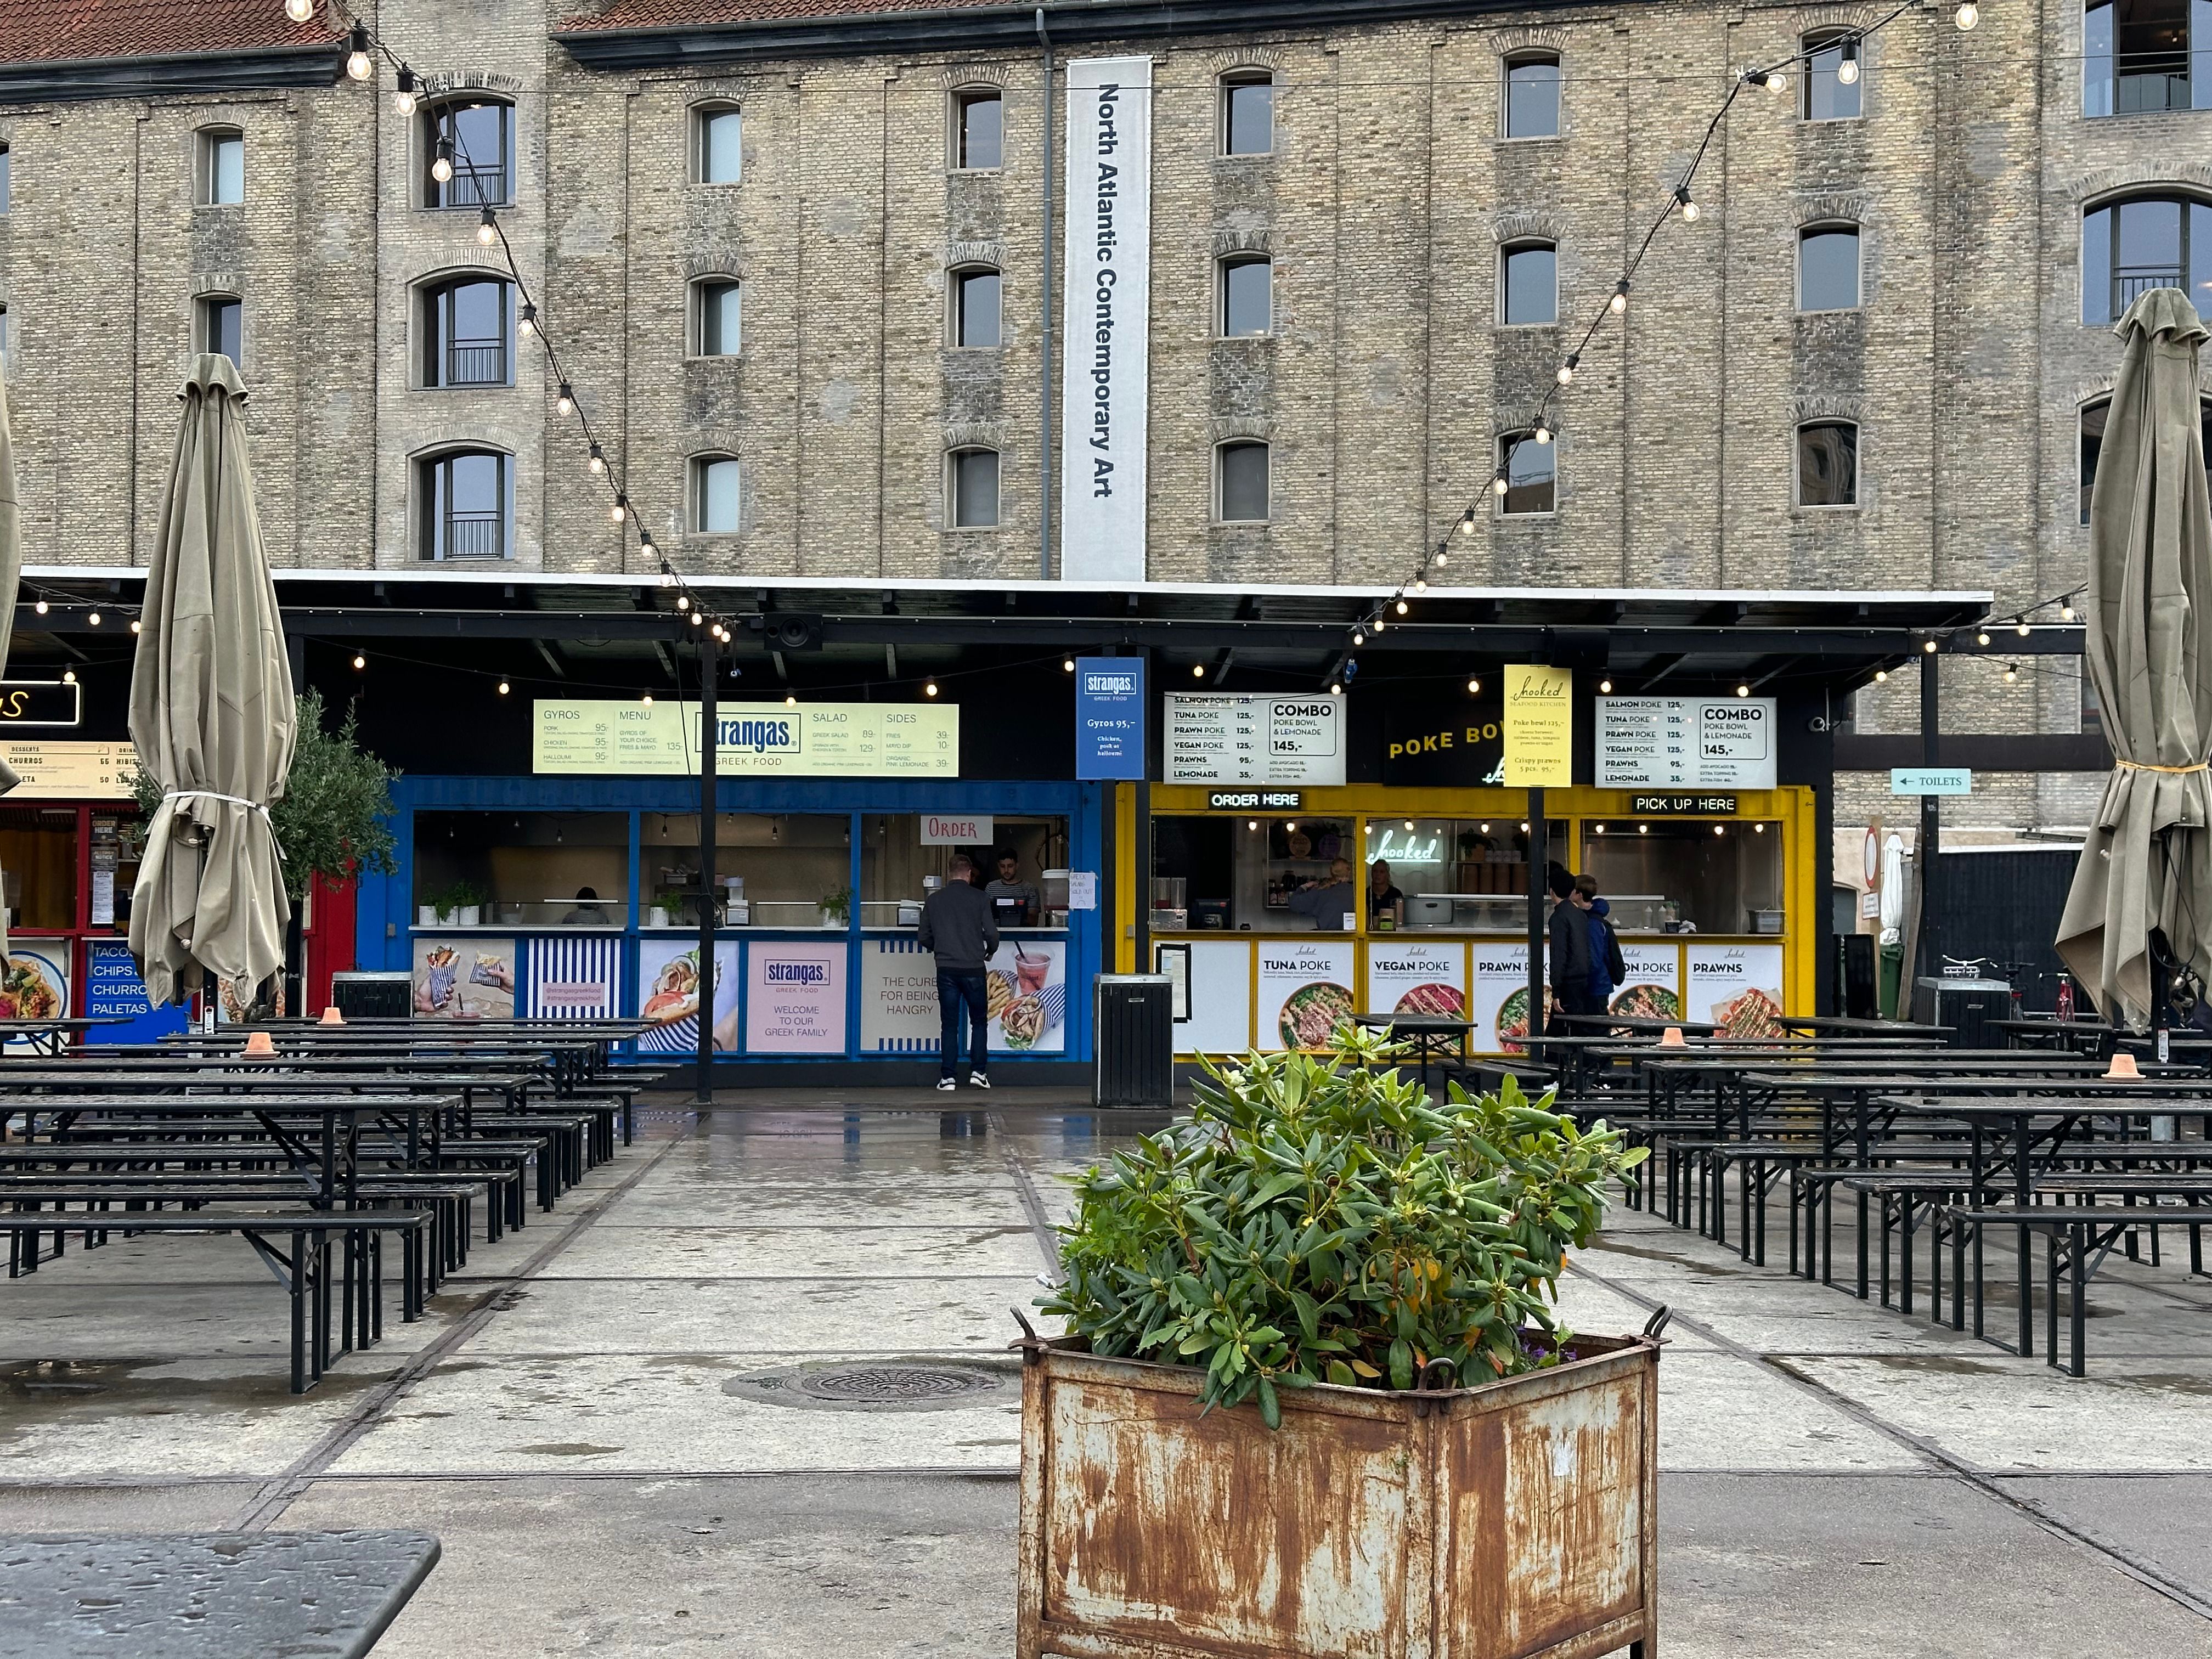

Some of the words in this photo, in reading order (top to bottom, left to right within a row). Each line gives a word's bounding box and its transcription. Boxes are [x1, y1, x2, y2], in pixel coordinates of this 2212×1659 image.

[1098, 83, 1119, 155] North
[1097, 162, 1118, 262] Atlantic
[1090, 268, 1117, 452] Contemporary
[1094, 457, 1114, 498] Art
[1088, 676, 1131, 695] strangas
[1513, 676, 1564, 701] hooked
[1274, 704, 1331, 716] COMBO
[1705, 709, 1762, 720] COMBO
[544, 711, 580, 720] GYROS
[620, 712, 651, 720] MENU
[812, 714, 847, 722] SALAD
[886, 714, 916, 723] SIDES
[1087, 719, 1114, 729] Gyros
[716, 718, 790, 753] trangas
[1390, 732, 1453, 759] POKE
[1466, 720, 1505, 743] BO
[1274, 741, 1302, 752] 145,-
[1705, 744, 1733, 755] 145,-
[1919, 777, 1962, 786] TOILETS
[1212, 794, 1259, 806] ORDER
[1263, 794, 1299, 805] HERE
[1637, 798, 1668, 810] PICK
[1674, 798, 1692, 810] UP
[1699, 799, 1735, 810] HERE
[929, 817, 978, 838] ORDER
[1365, 830, 1436, 865] hooked
[94, 947, 133, 957] TACO
[1264, 961, 1296, 969] TUNA
[1300, 961, 1331, 970] POKE
[1375, 961, 1415, 970] VEGAN
[1419, 961, 1450, 971] POKE
[1479, 962, 1521, 972] PRAWN
[1643, 963, 1673, 973] POKE
[1694, 963, 1742, 973] PRAWNS
[94, 966, 132, 976] CHIPS
[769, 963, 823, 985] strangas
[882, 977, 905, 986] THE
[907, 977, 938, 986] CURE
[93, 985, 148, 995] CHURRO
[881, 991, 903, 1001] FOR
[906, 991, 939, 1001] BEING
[92, 1004, 147, 1014] PALETAS
[774, 1006, 820, 1014] WELCOME
[887, 1005, 933, 1014] HANGRY
[779, 1017, 791, 1025] TO
